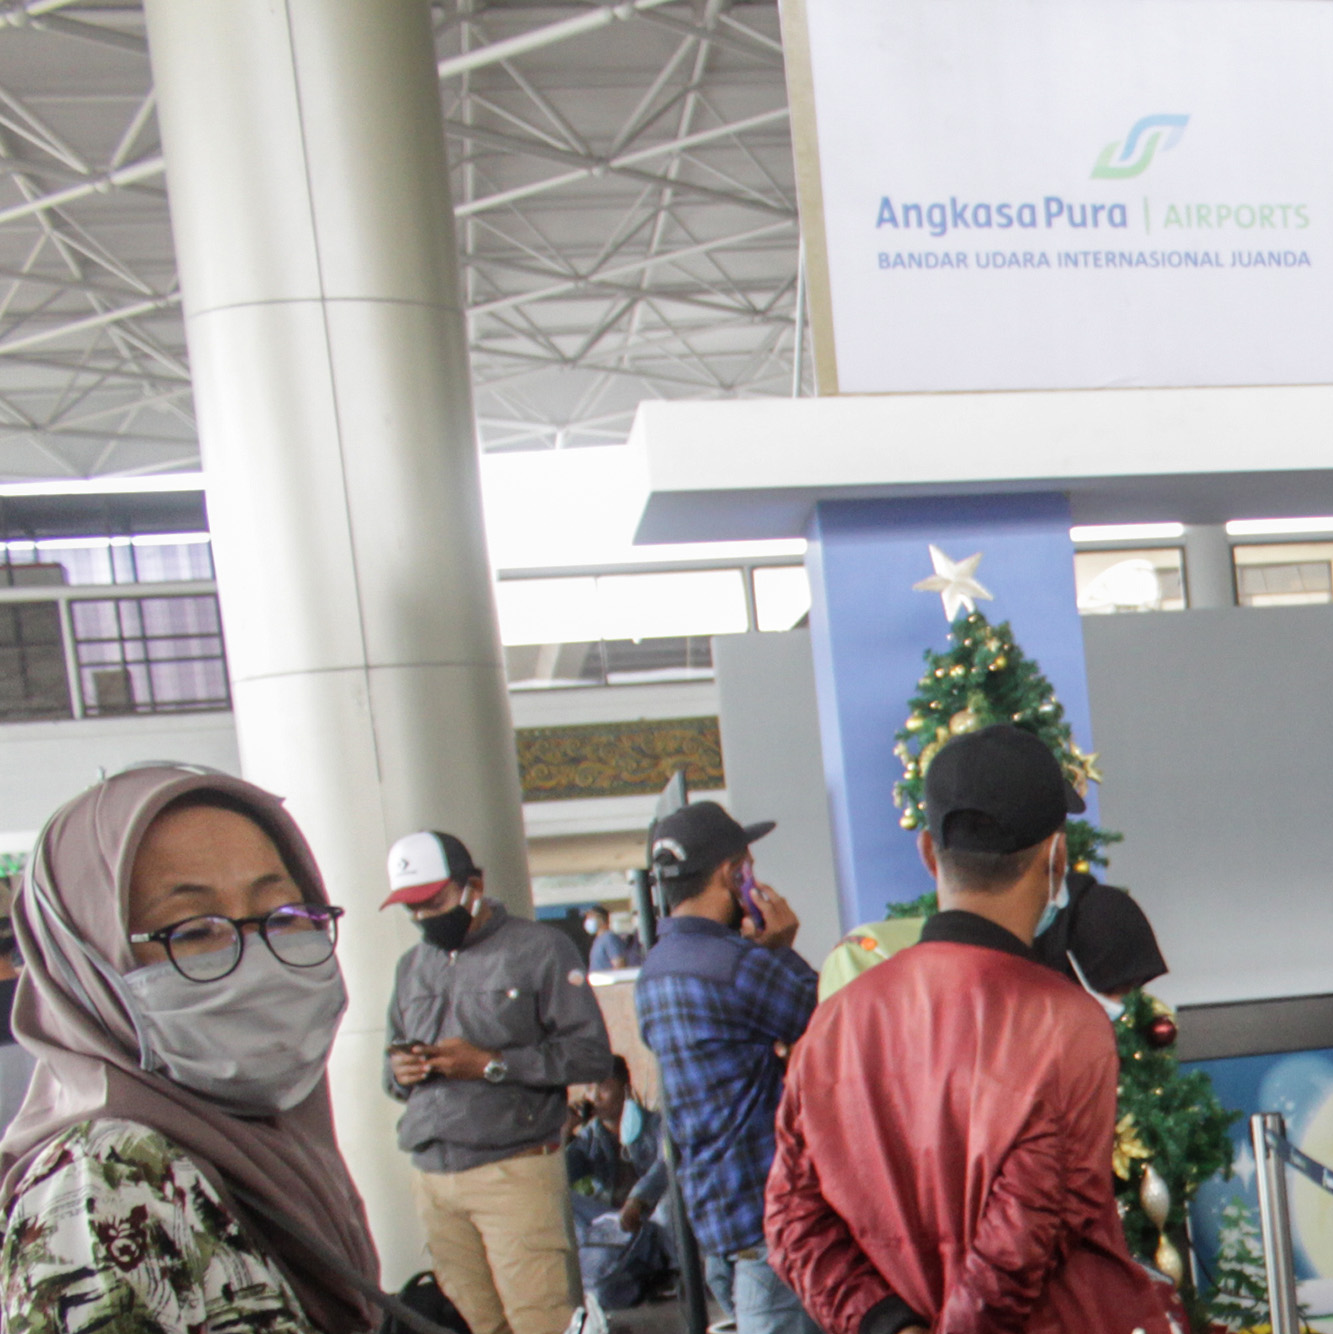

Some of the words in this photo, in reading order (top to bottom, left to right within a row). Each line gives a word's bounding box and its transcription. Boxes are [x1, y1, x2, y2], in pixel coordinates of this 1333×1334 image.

[1163, 203, 1310, 231] AIRPORTS
[878, 251, 968, 270] BANDAR
[976, 251, 1050, 270] UDARA
[1057, 250, 1225, 269] INTERNASIONAL
[1230, 250, 1311, 268] JUANDA
